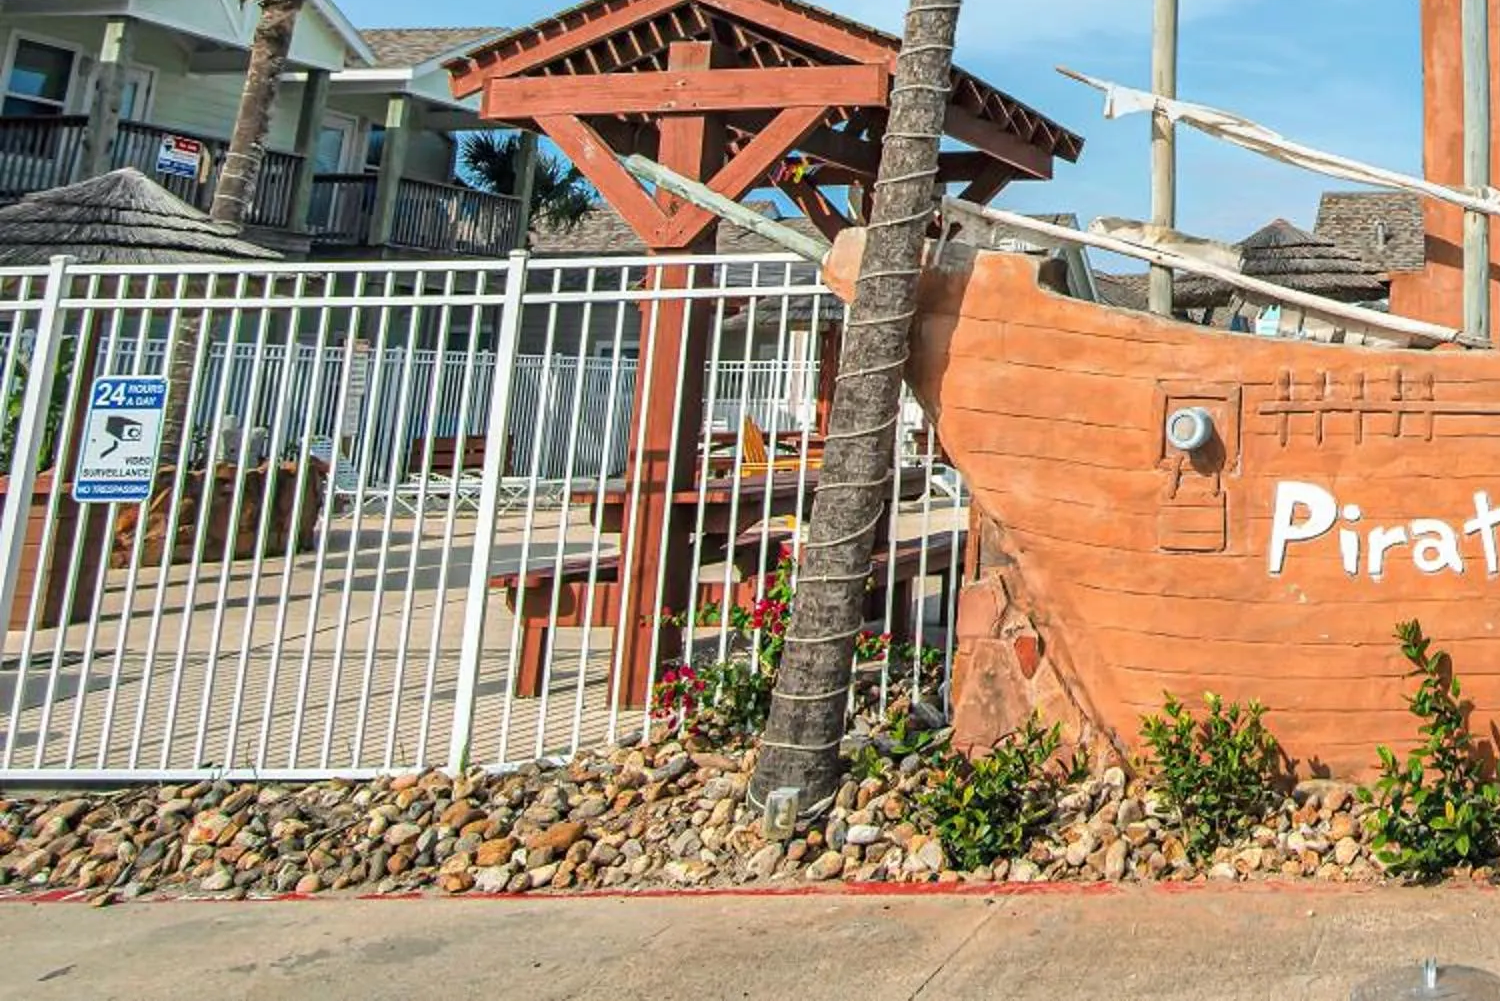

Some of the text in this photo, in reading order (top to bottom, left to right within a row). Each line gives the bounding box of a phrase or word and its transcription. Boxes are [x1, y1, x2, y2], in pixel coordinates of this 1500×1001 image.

[95, 382, 127, 406] 24
[127, 384, 165, 394] HOURS
[125, 396, 157, 406] A DAY
[125, 456, 151, 465] VIDEO
[82, 468, 150, 478] SURVEILLANCE
[77, 484, 149, 495] NO TRESPASSING
